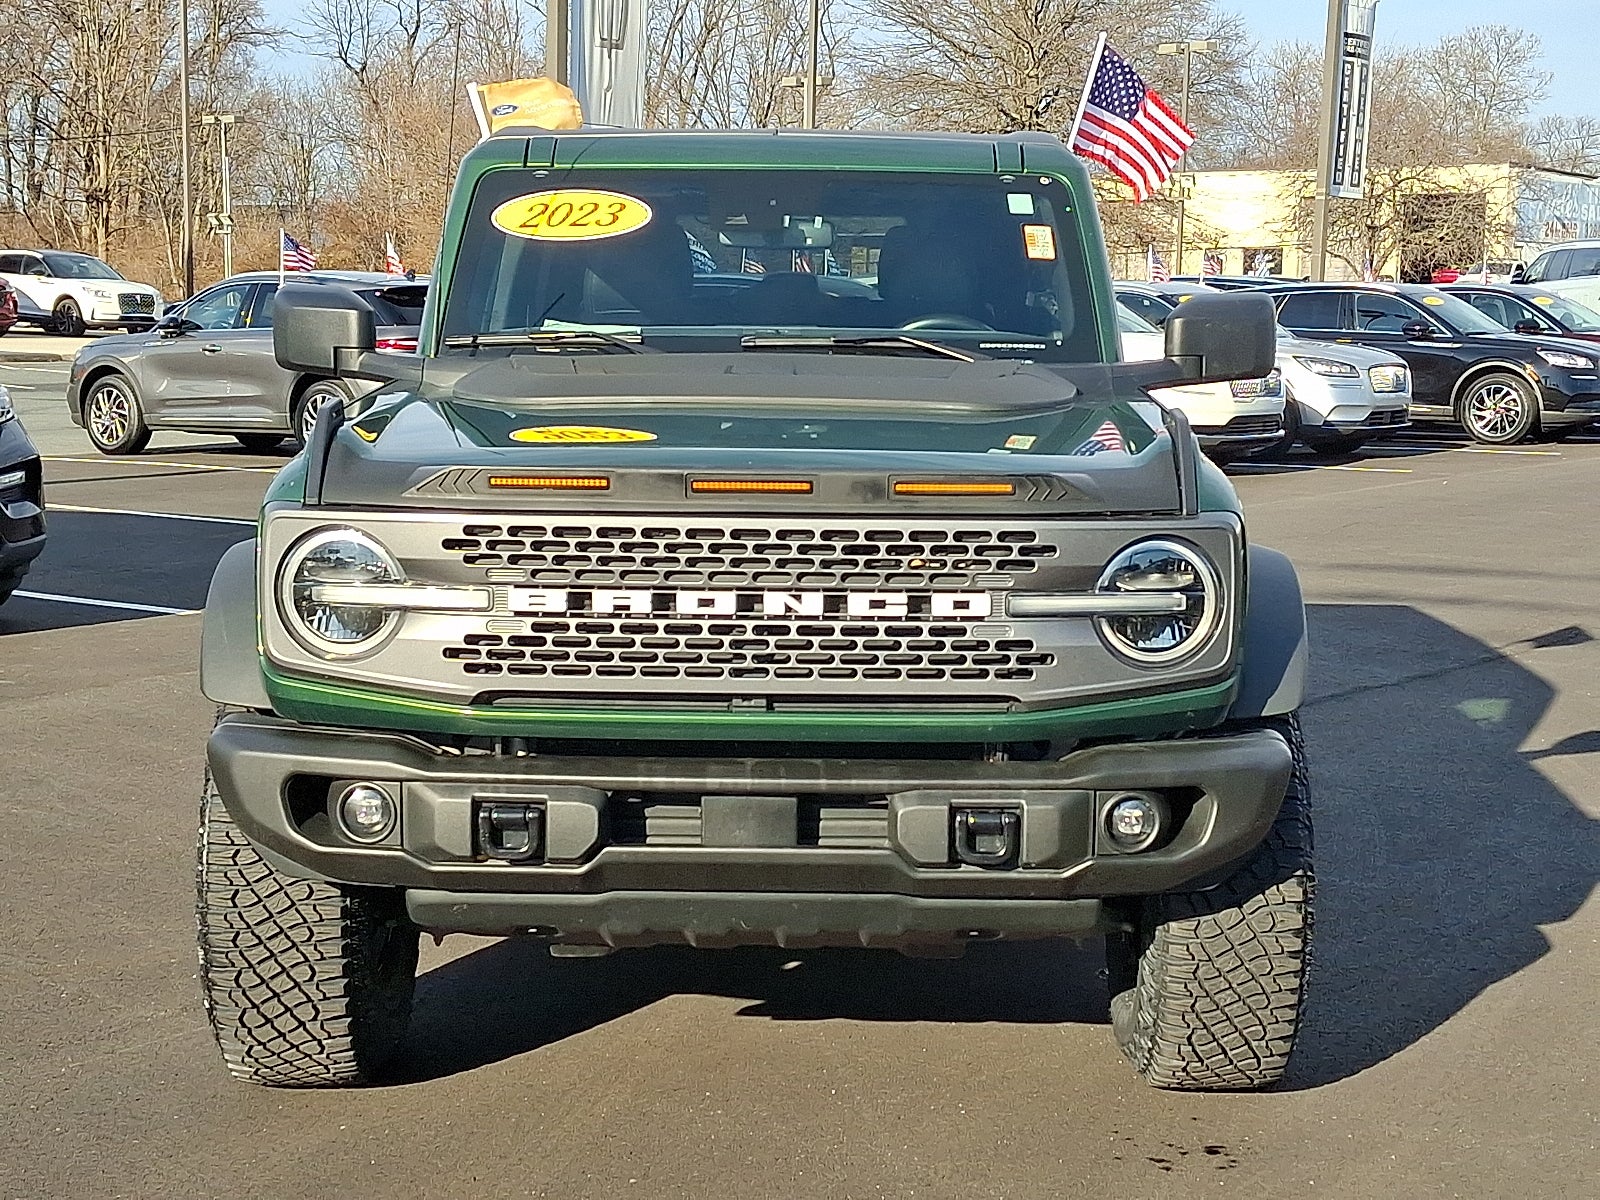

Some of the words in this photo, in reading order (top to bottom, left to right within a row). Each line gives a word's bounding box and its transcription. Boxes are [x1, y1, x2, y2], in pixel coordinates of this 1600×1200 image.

[1334, 62, 1352, 184] CERTIFIED
[518, 202, 627, 229] 2023
[507, 587, 992, 618] BRONCO
